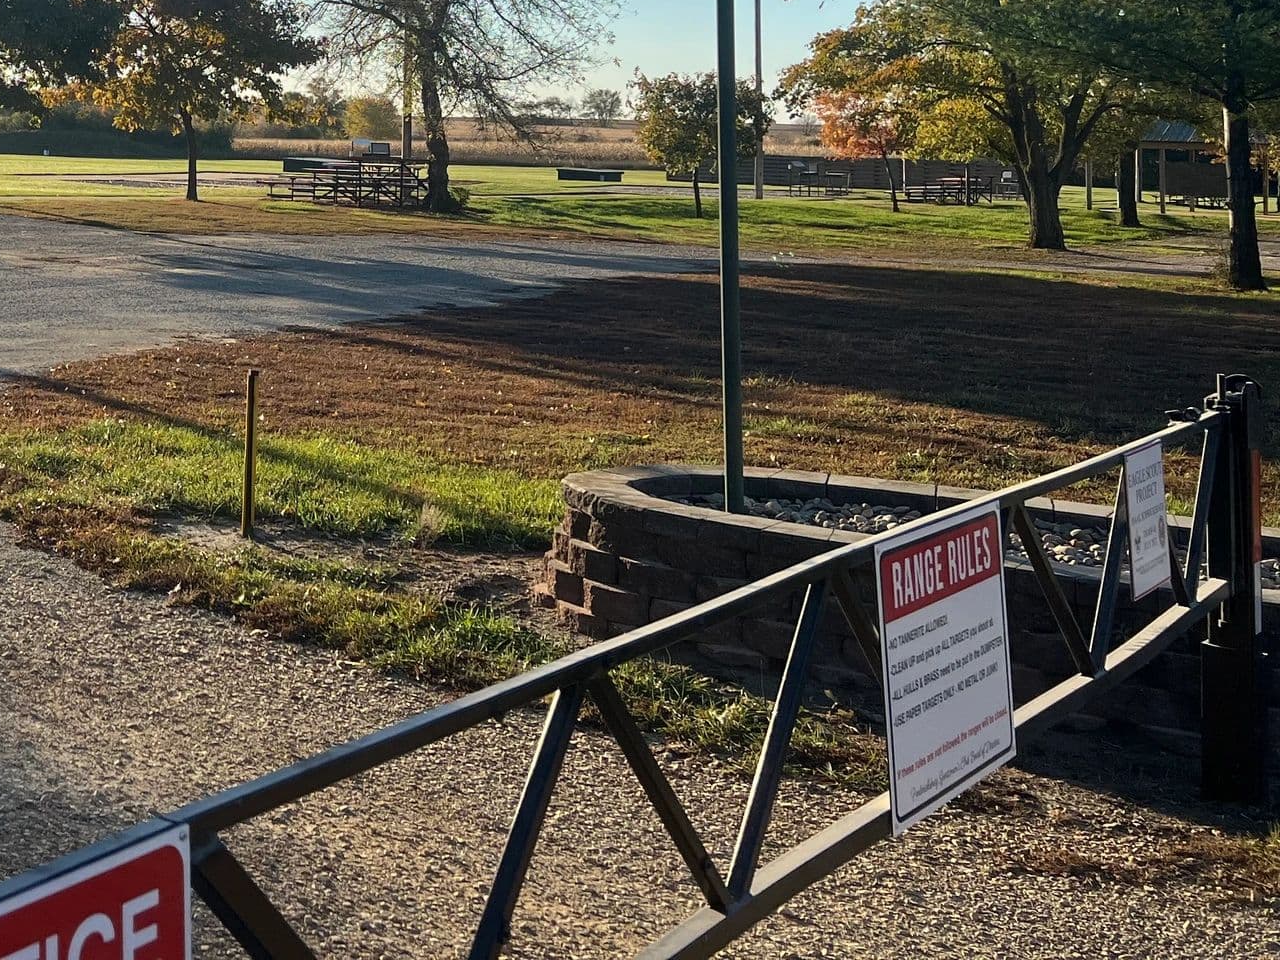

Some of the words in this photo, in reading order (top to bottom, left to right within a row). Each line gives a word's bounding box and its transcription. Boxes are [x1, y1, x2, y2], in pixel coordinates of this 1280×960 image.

[892, 545, 945, 609] RANGE
[947, 526, 992, 585] RULES
[949, 628, 969, 646] TARGETS
[921, 691, 943, 713] TARGETS
